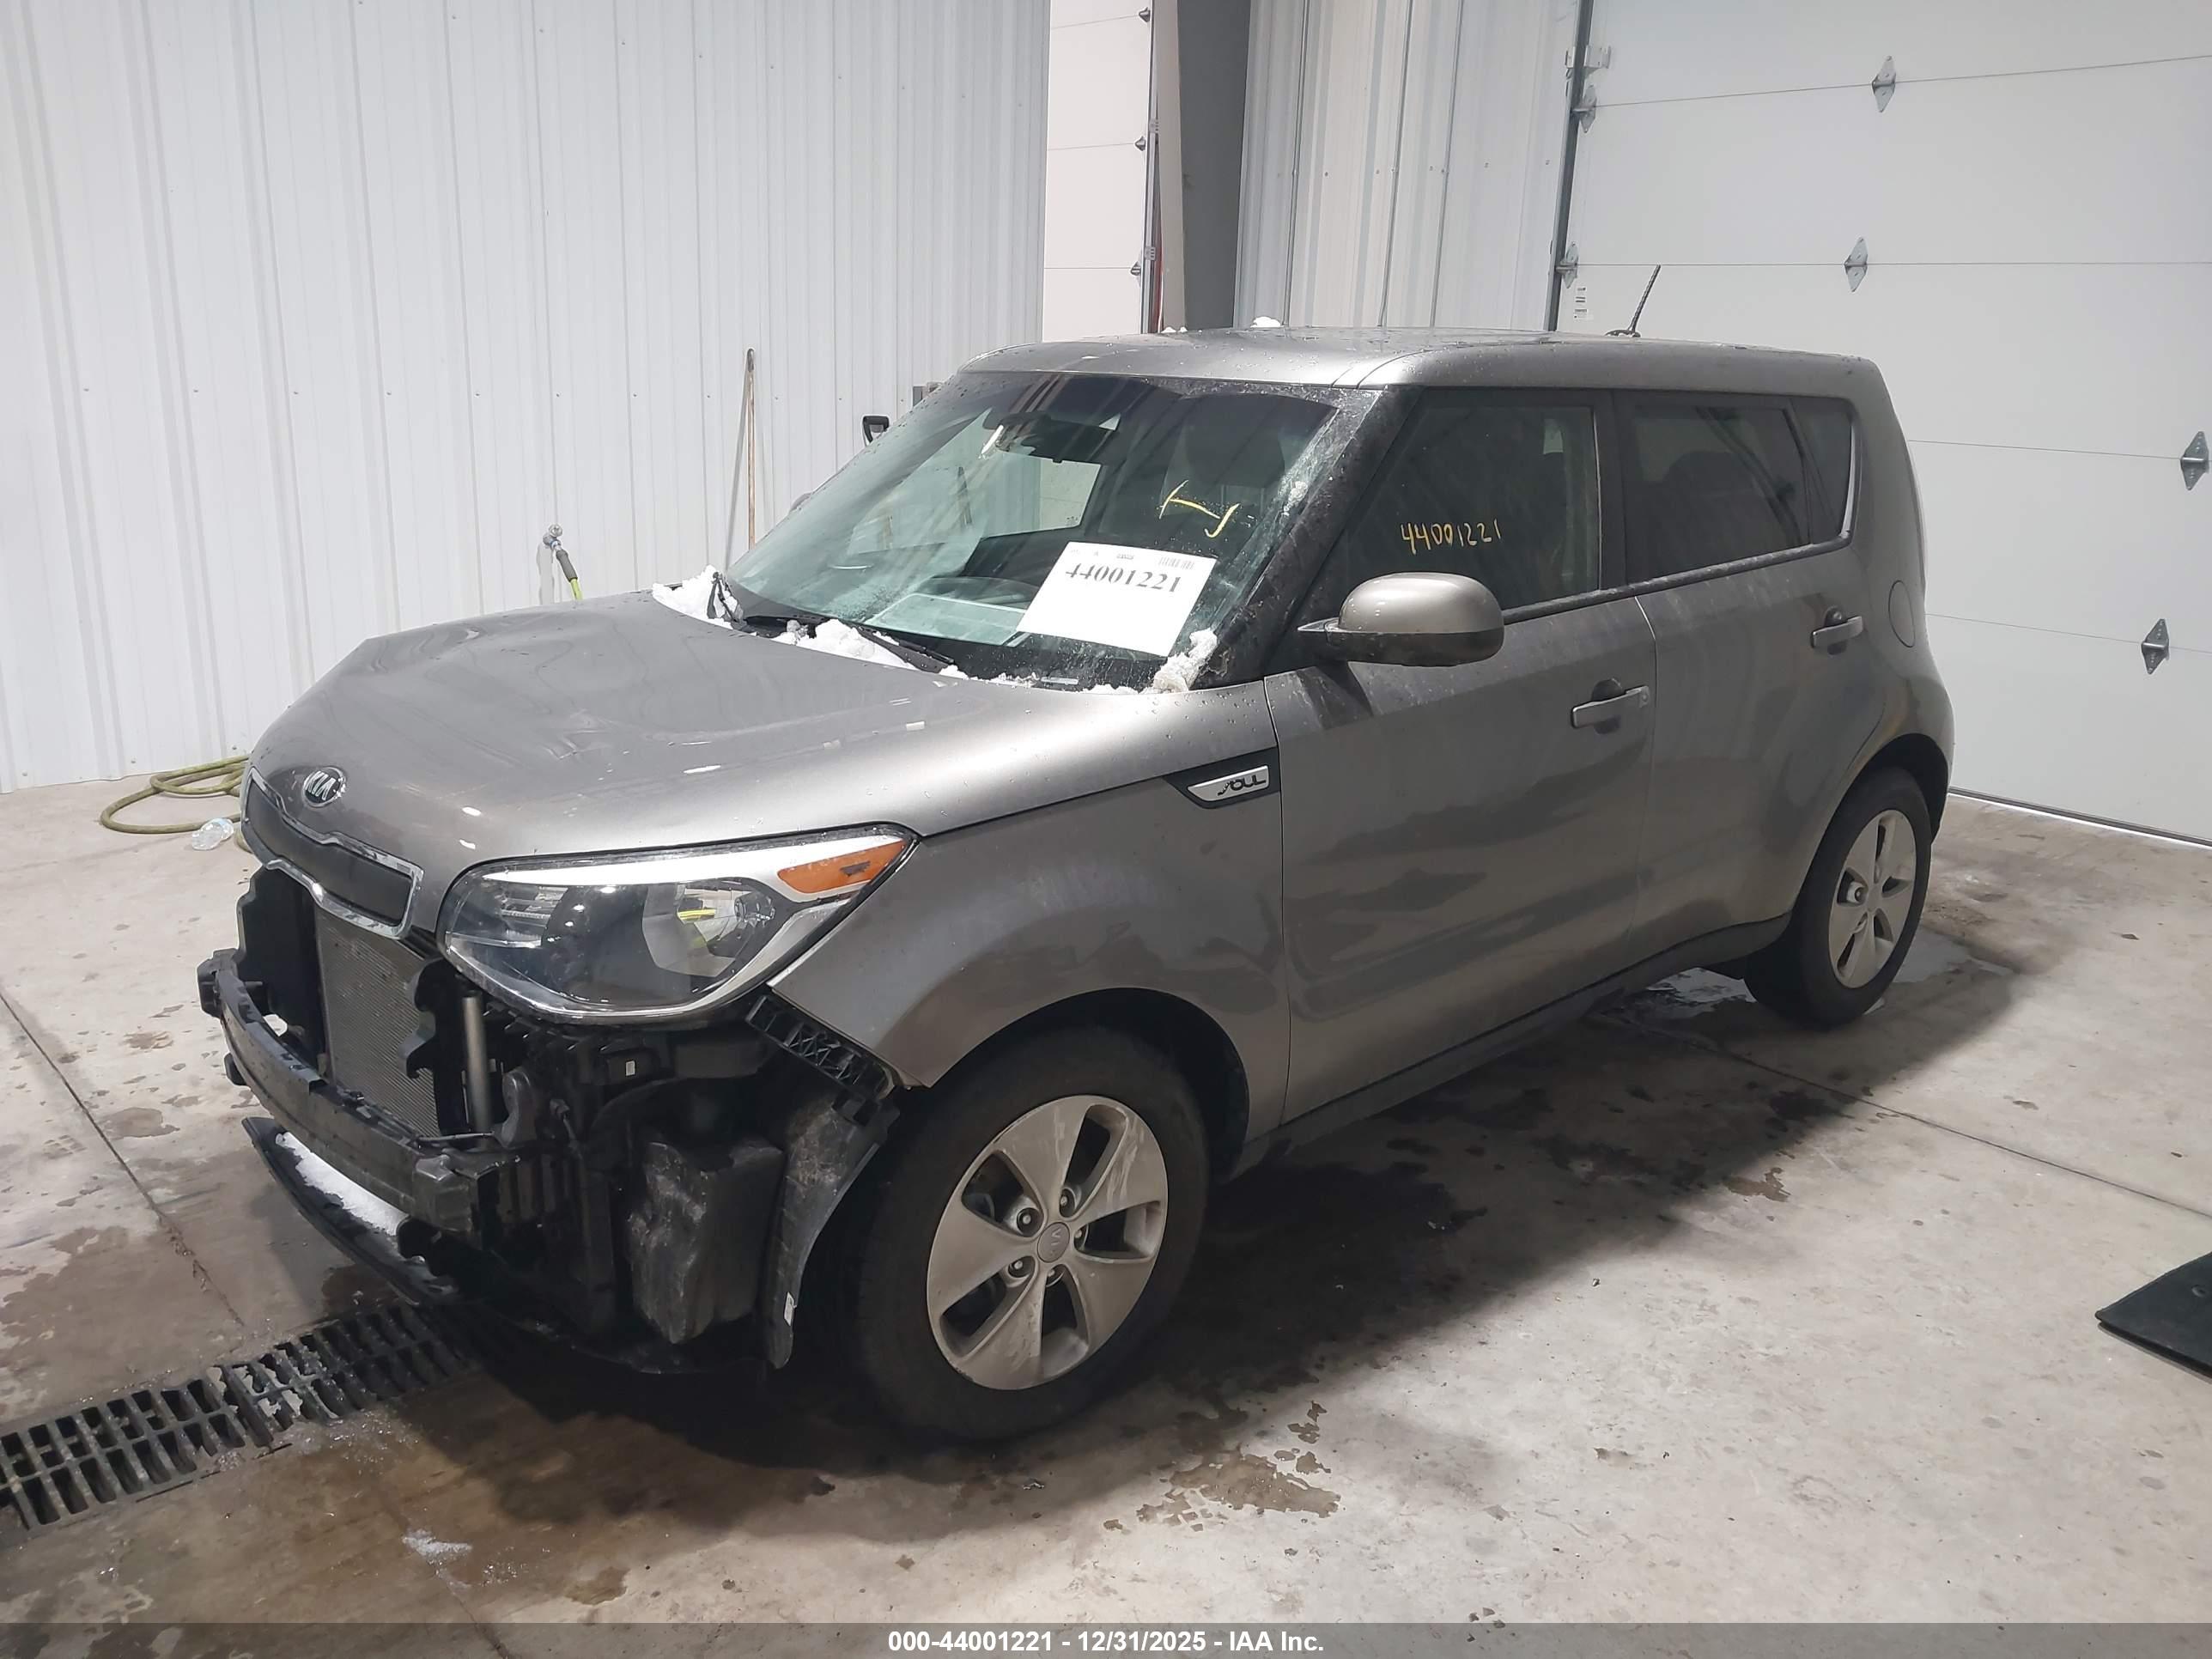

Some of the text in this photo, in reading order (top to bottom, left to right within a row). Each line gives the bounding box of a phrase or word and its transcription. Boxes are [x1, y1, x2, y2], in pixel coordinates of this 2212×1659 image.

[1401, 519, 1501, 555] 44001221
[1065, 562, 1182, 592] 44001221
[305, 770, 337, 801] KIA
